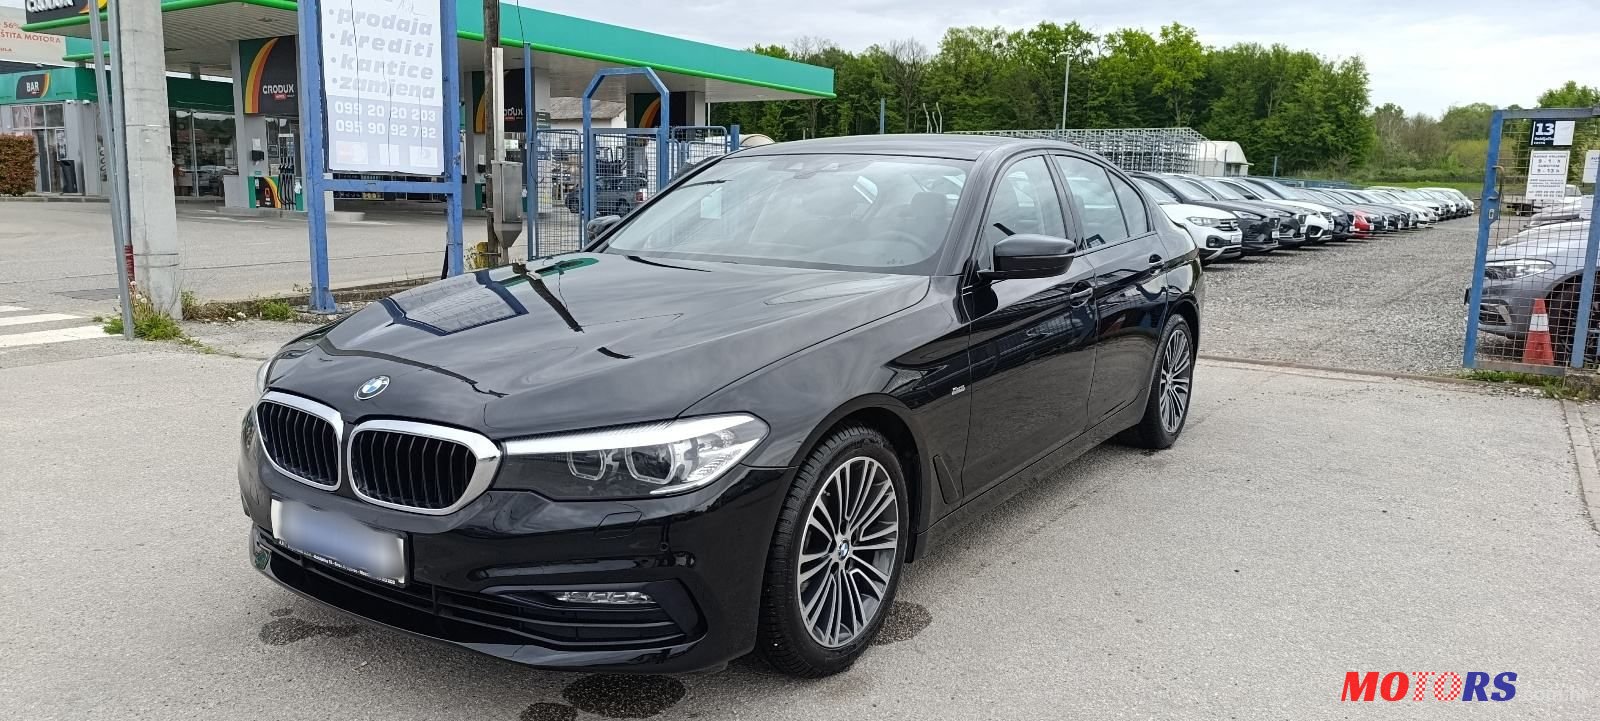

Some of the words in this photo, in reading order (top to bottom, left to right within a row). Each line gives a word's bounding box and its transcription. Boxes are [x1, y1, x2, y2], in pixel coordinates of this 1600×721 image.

[337, 8, 433, 36] prodaja
[24, 34, 61, 43] MOTORA
[340, 30, 434, 58] krediti
[341, 53, 434, 80] kartice
[26, 81, 40, 92] BAR
[262, 84, 295, 94] CRODUX
[339, 76, 436, 99] zamjena
[367, 104, 385, 117] 20
[391, 106, 407, 119] 20
[411, 109, 436, 122] 203
[335, 119, 363, 133] 095
[367, 122, 386, 135] 90
[390, 123, 408, 137] 92
[1535, 123, 1554, 136] 13
